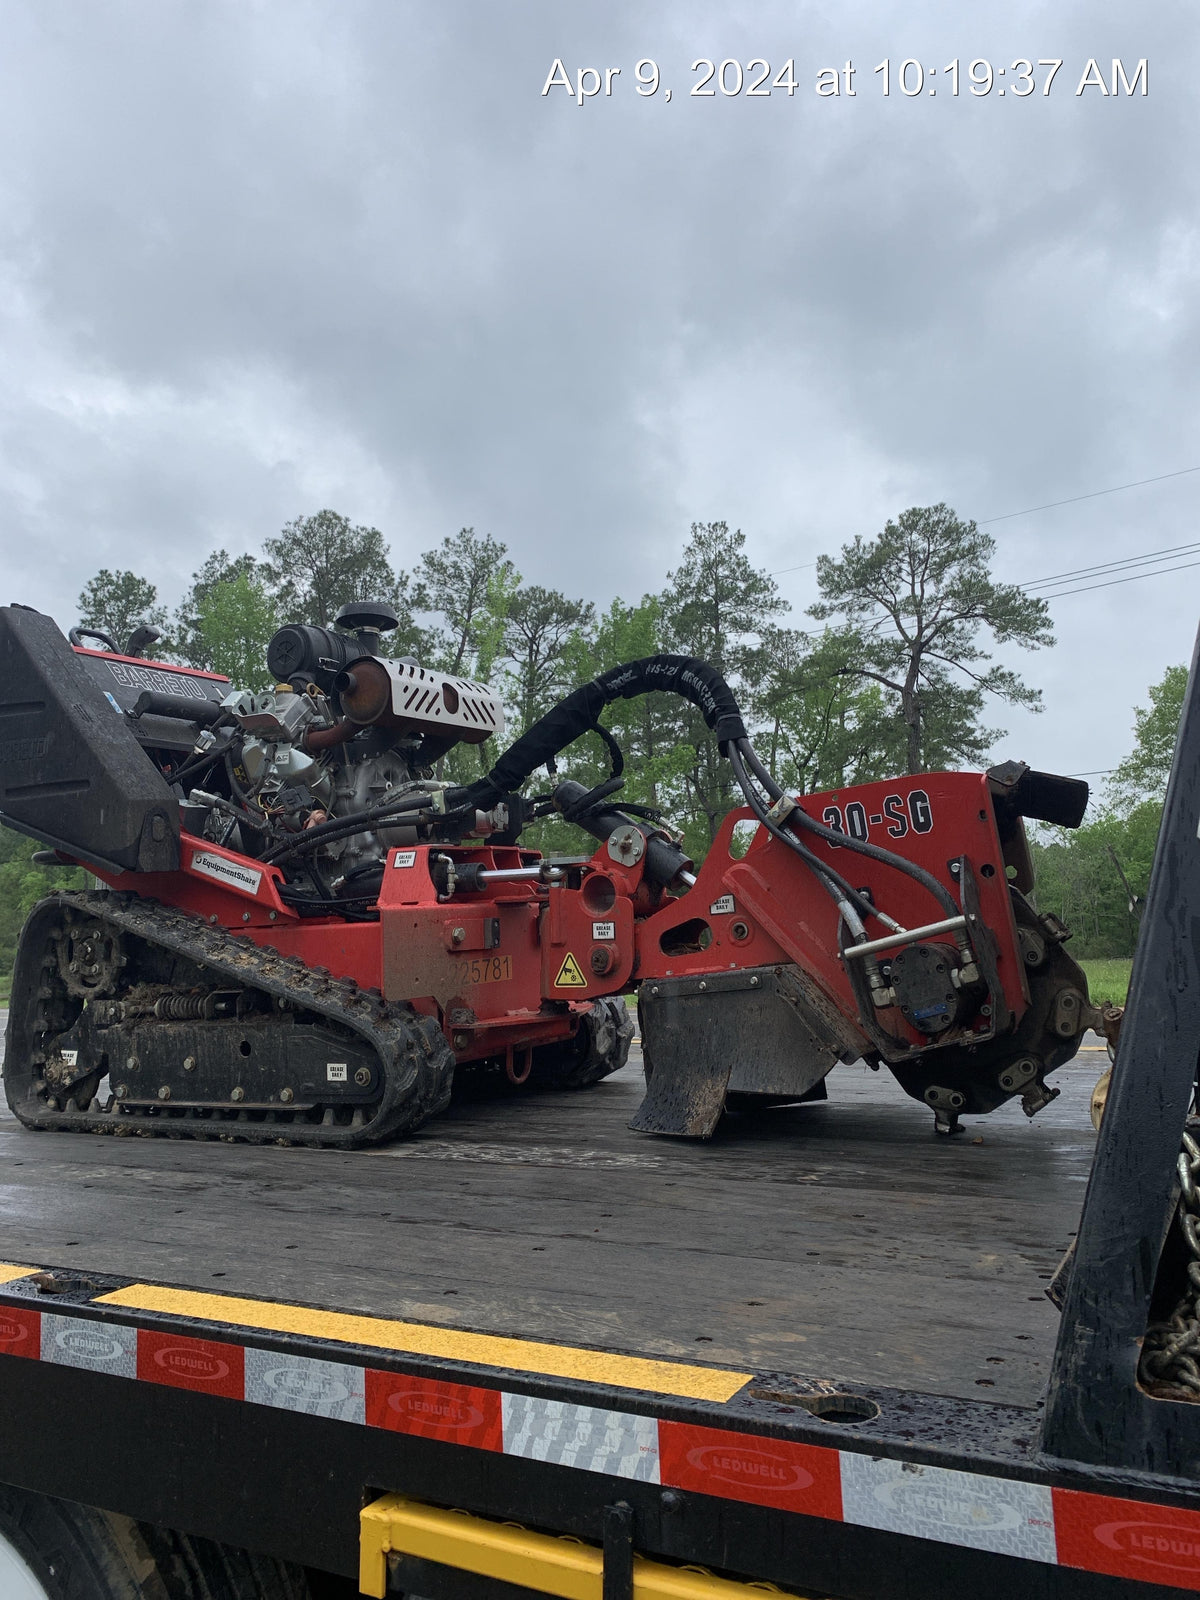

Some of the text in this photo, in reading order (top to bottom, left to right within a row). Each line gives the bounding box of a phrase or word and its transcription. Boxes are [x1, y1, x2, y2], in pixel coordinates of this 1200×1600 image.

[105, 661, 208, 700] BARRETO
[822, 789, 934, 849] 30-SG
[202, 858, 257, 886] EquipmentShare
[69, 1336, 109, 1352] LEDWELL
[169, 1354, 214, 1372] LEDWELL
[408, 1399, 464, 1420] LEDWELL
[713, 1455, 787, 1481] LEDWELL
